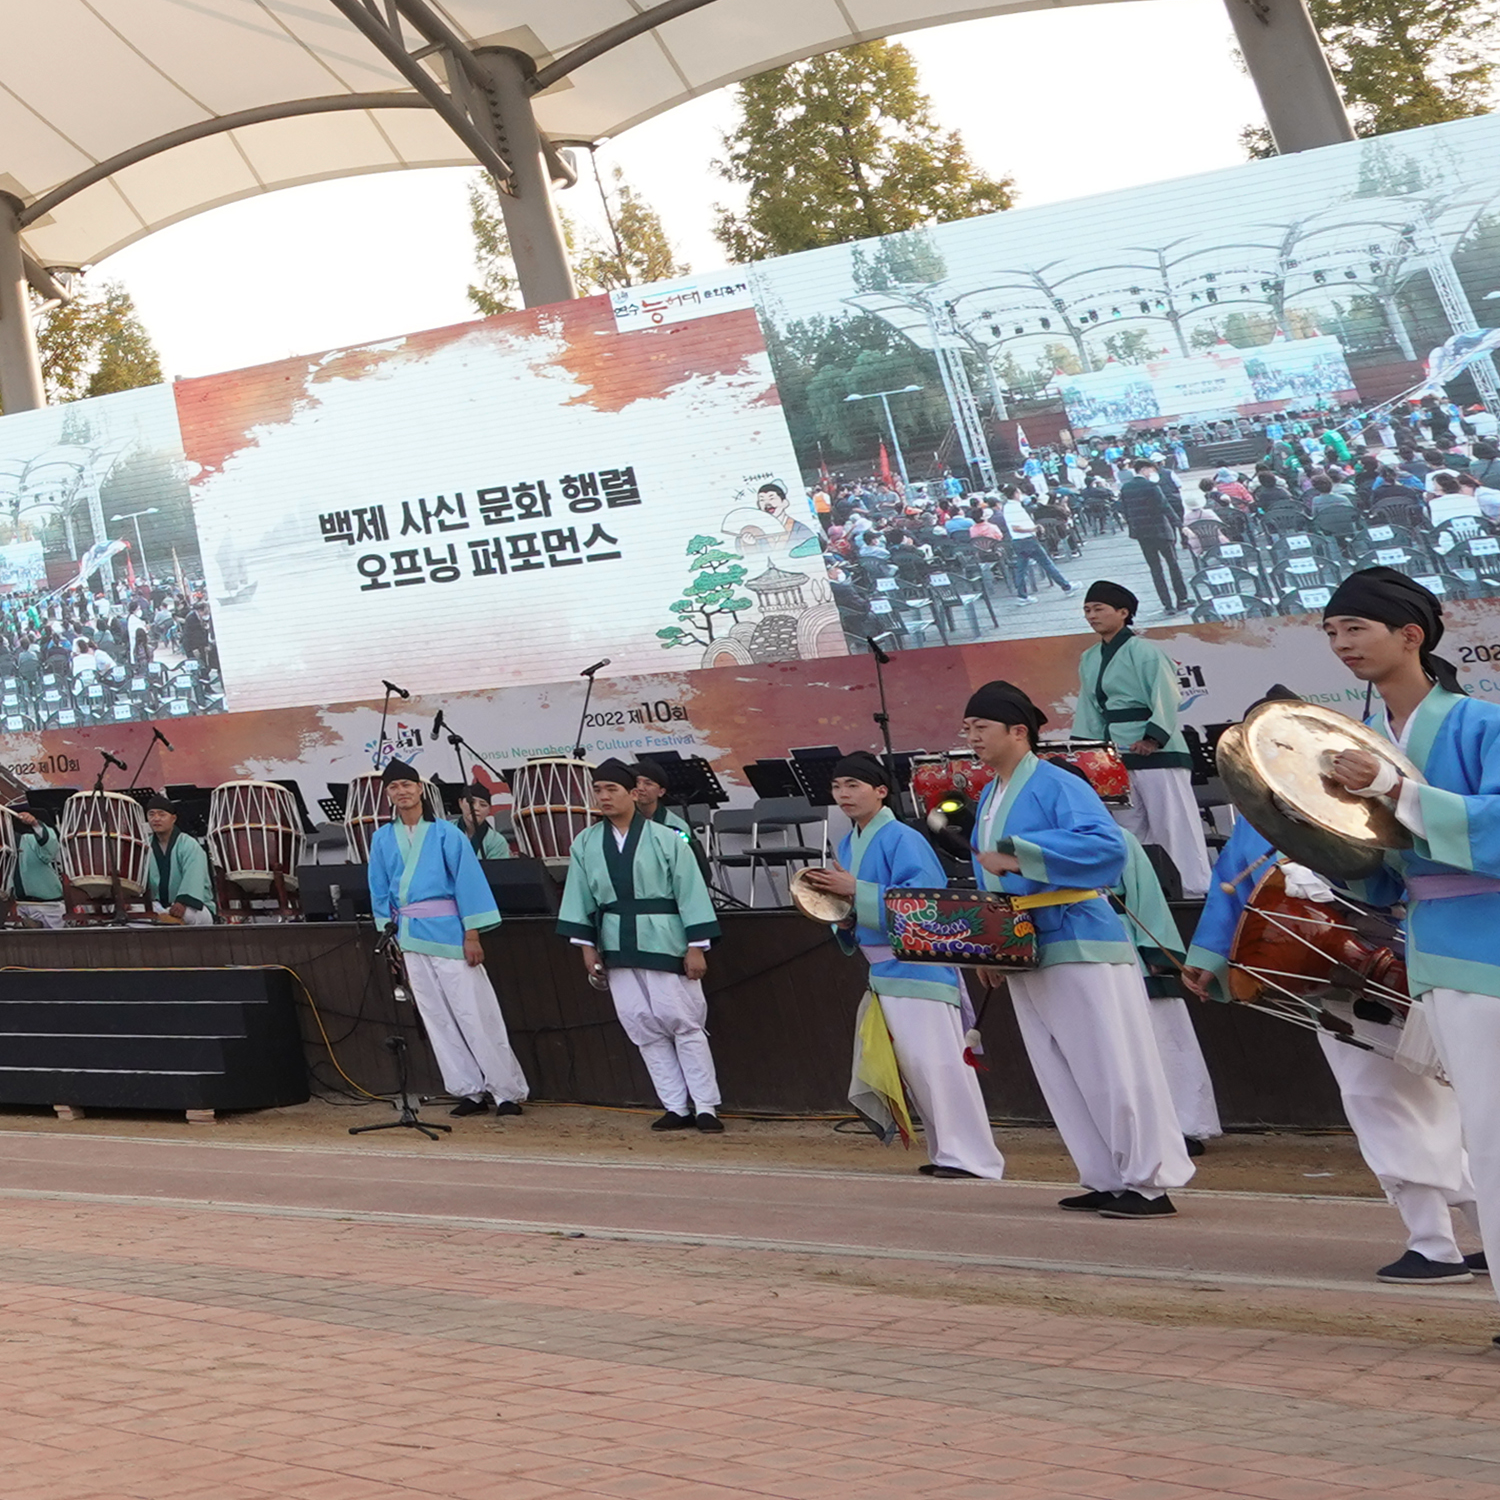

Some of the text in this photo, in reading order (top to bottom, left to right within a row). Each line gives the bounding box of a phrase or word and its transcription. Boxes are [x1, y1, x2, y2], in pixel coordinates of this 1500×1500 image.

[613, 303, 640, 318] 연수
[641, 290, 701, 324] 능허대
[318, 466, 642, 546] 백제 사신 문화 행렬
[356, 522, 622, 592] 오프닝 퍼포먼스
[584, 700, 689, 728] 2022 제10회
[596, 739, 643, 751] Culture
[645, 734, 696, 747] Festival
[38, 754, 80, 774] 제10회
